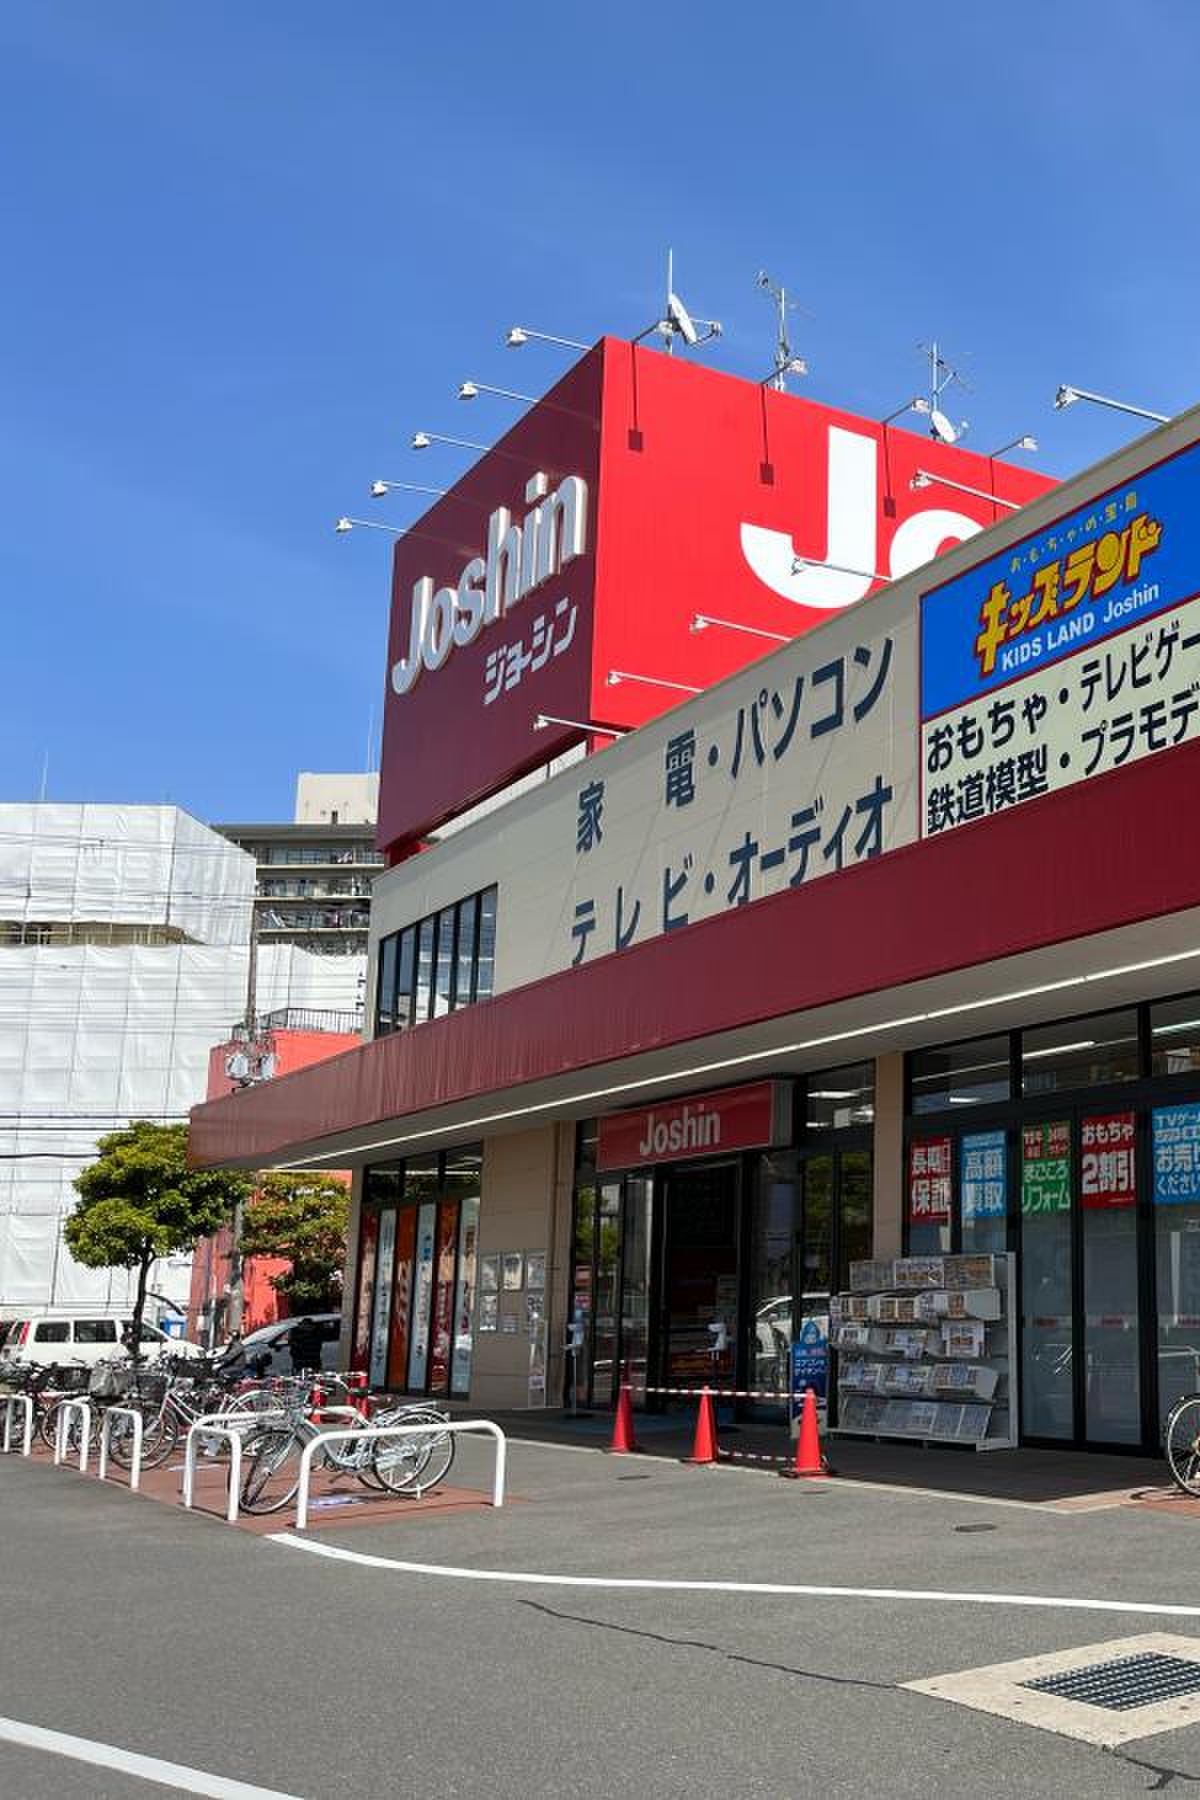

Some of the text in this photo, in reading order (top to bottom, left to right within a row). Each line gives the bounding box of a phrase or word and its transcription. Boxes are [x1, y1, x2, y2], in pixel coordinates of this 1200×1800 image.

[392, 472, 588, 694] Joshin
[976, 513, 1162, 677] キッズランド
[1002, 583, 1160, 672] KIDS LAND Joshin
[484, 597, 577, 704] ジョーシン
[571, 777, 893, 966] テレビ・オーディオ
[639, 1103, 721, 1154] Joshin
[1082, 1121, 1135, 1145] おもちゃ
